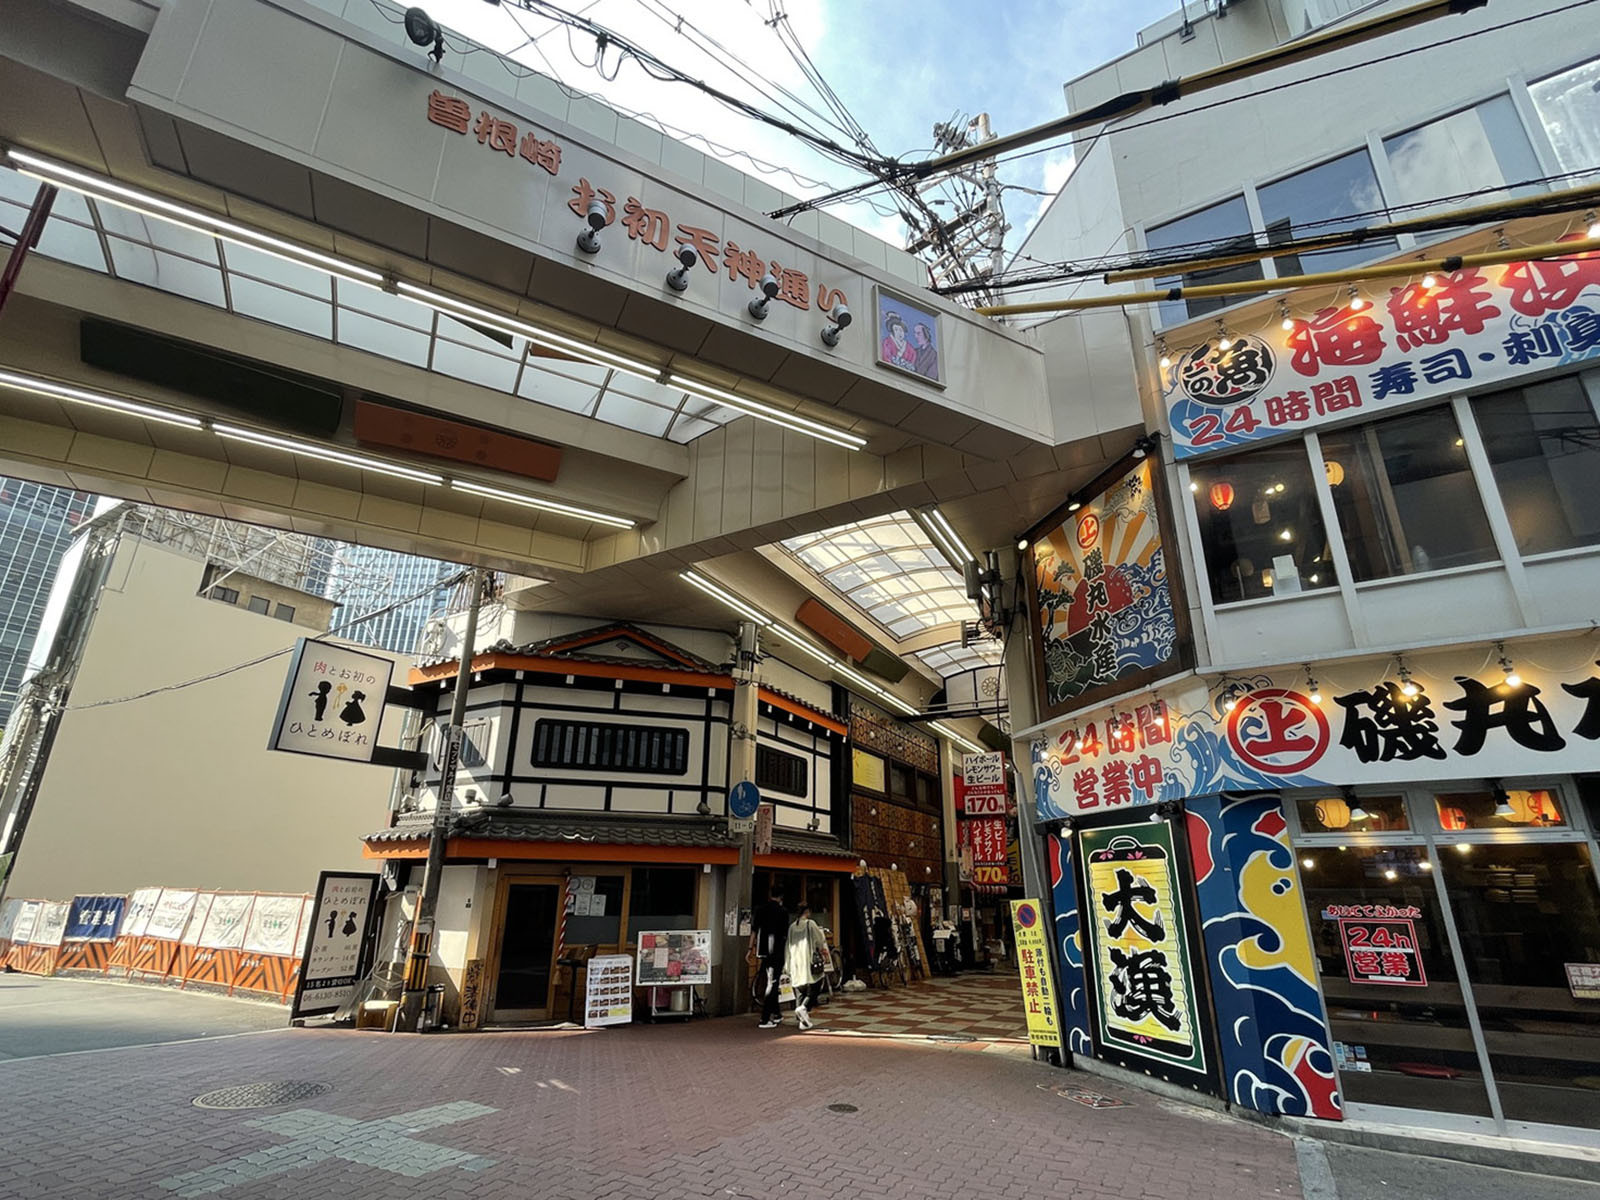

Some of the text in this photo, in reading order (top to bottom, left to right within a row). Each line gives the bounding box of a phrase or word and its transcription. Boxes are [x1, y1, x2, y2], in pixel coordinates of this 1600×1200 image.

[568, 177, 848, 322] お初天神通り
[1190, 375, 1363, 447] 24時間
[1082, 546, 1118, 678] 磯丸水産
[314, 661, 376, 685] 肉とお初の
[289, 721, 369, 746] ひとめぼれ
[1058, 698, 1171, 768] 24時間
[965, 754, 1000, 765] ハイボール
[965, 765, 1001, 774] レモンサワー
[967, 774, 1000, 784] 生ビール
[1072, 753, 1164, 811] 営業中
[973, 820, 983, 861] ハイボール
[984, 820, 993, 861] レモンサワー
[993, 820, 1005, 861] 生ビール
[324, 897, 366, 905] ひとめぼれ
[1326, 904, 1422, 918] あいててよかった
[1348, 927, 1412, 948] 24h
[1353, 951, 1410, 976] 営業
[1022, 948, 1042, 1014] 駐車禁止
